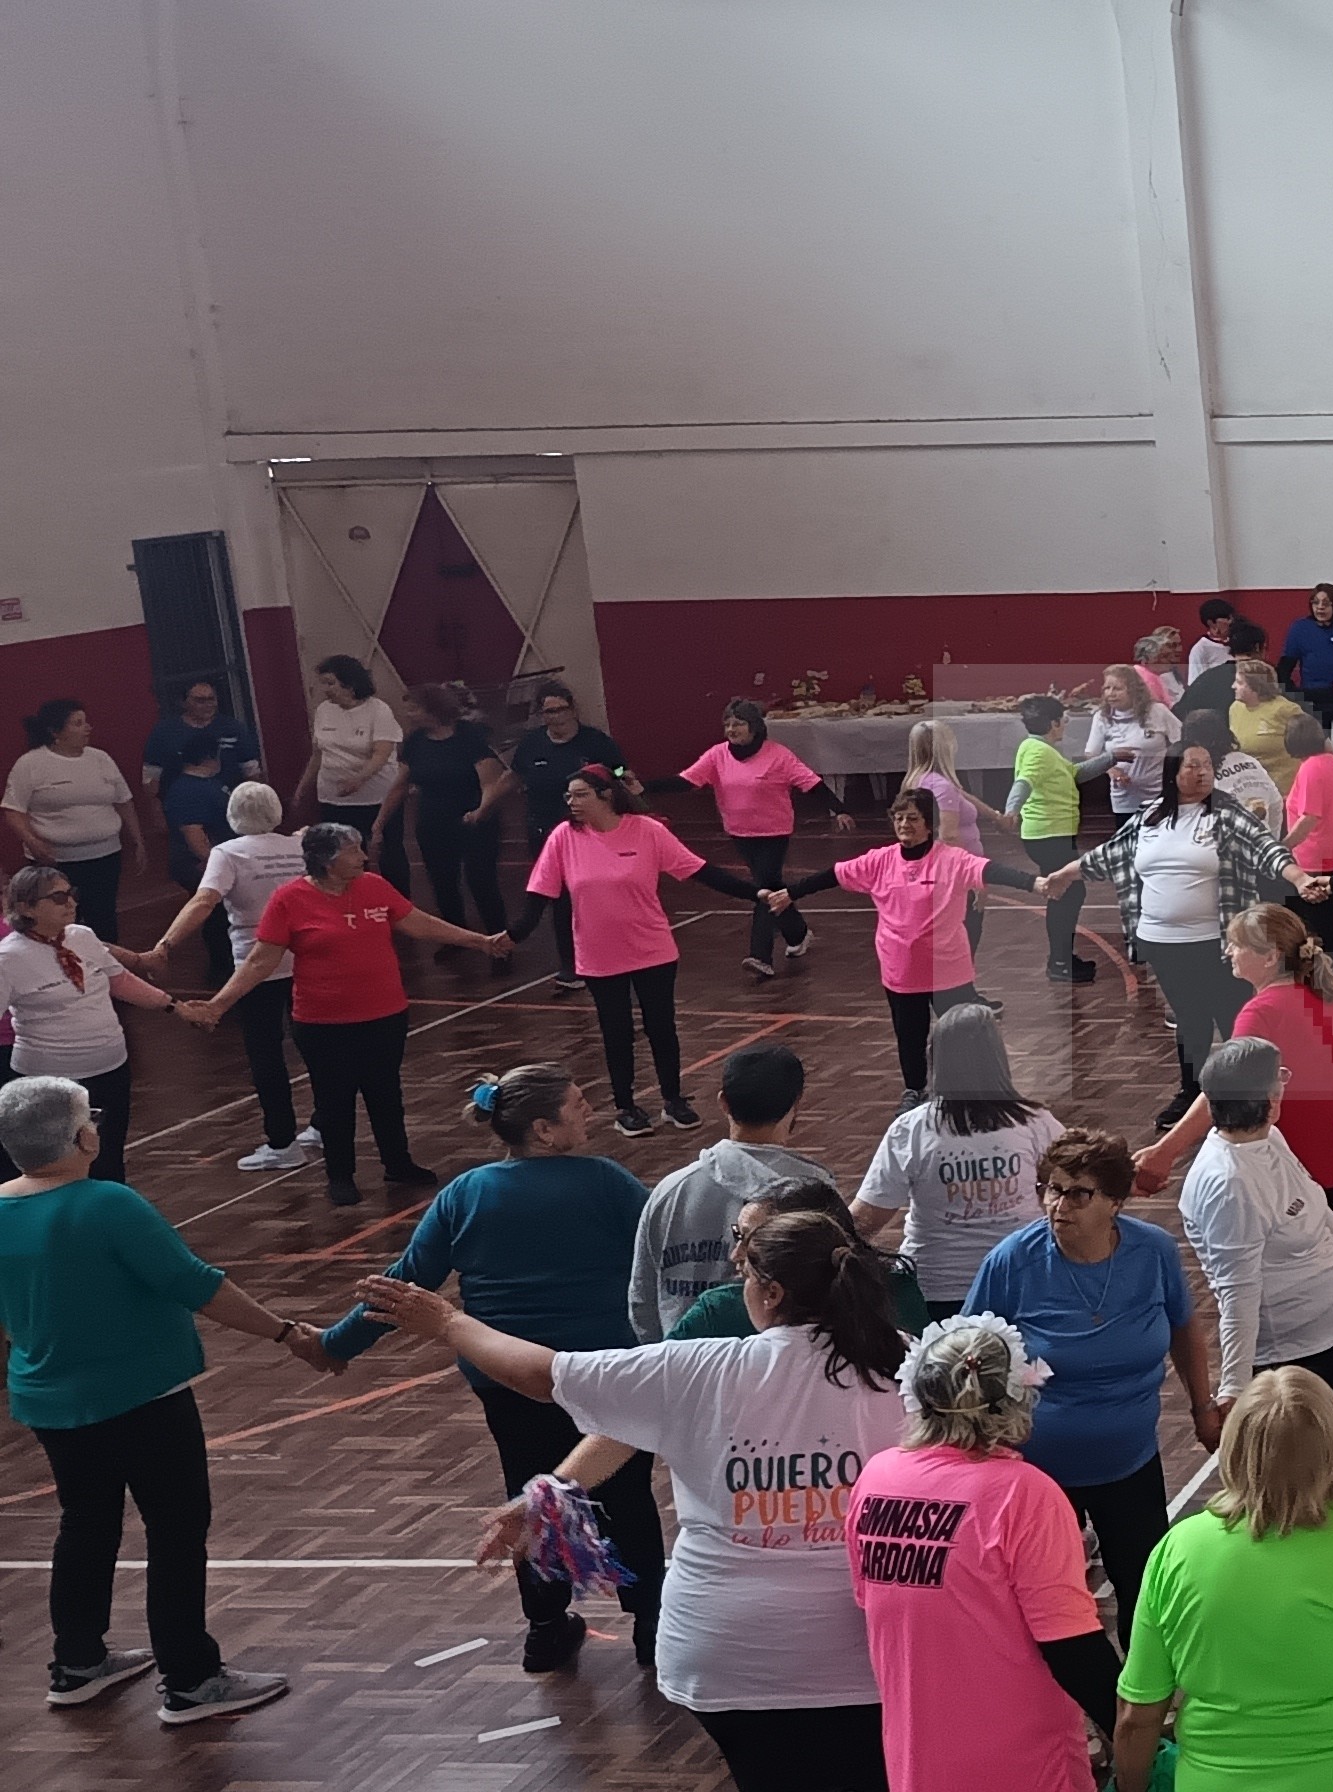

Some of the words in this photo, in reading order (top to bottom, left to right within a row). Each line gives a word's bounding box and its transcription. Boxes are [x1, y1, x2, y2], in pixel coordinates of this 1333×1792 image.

[939, 1153, 1021, 1185] QUIERO
[946, 1174, 1019, 1204] PUEDO
[725, 1450, 864, 1493] QUIERO
[762, 1525, 791, 1548] lo
[803, 1510, 847, 1545] har
